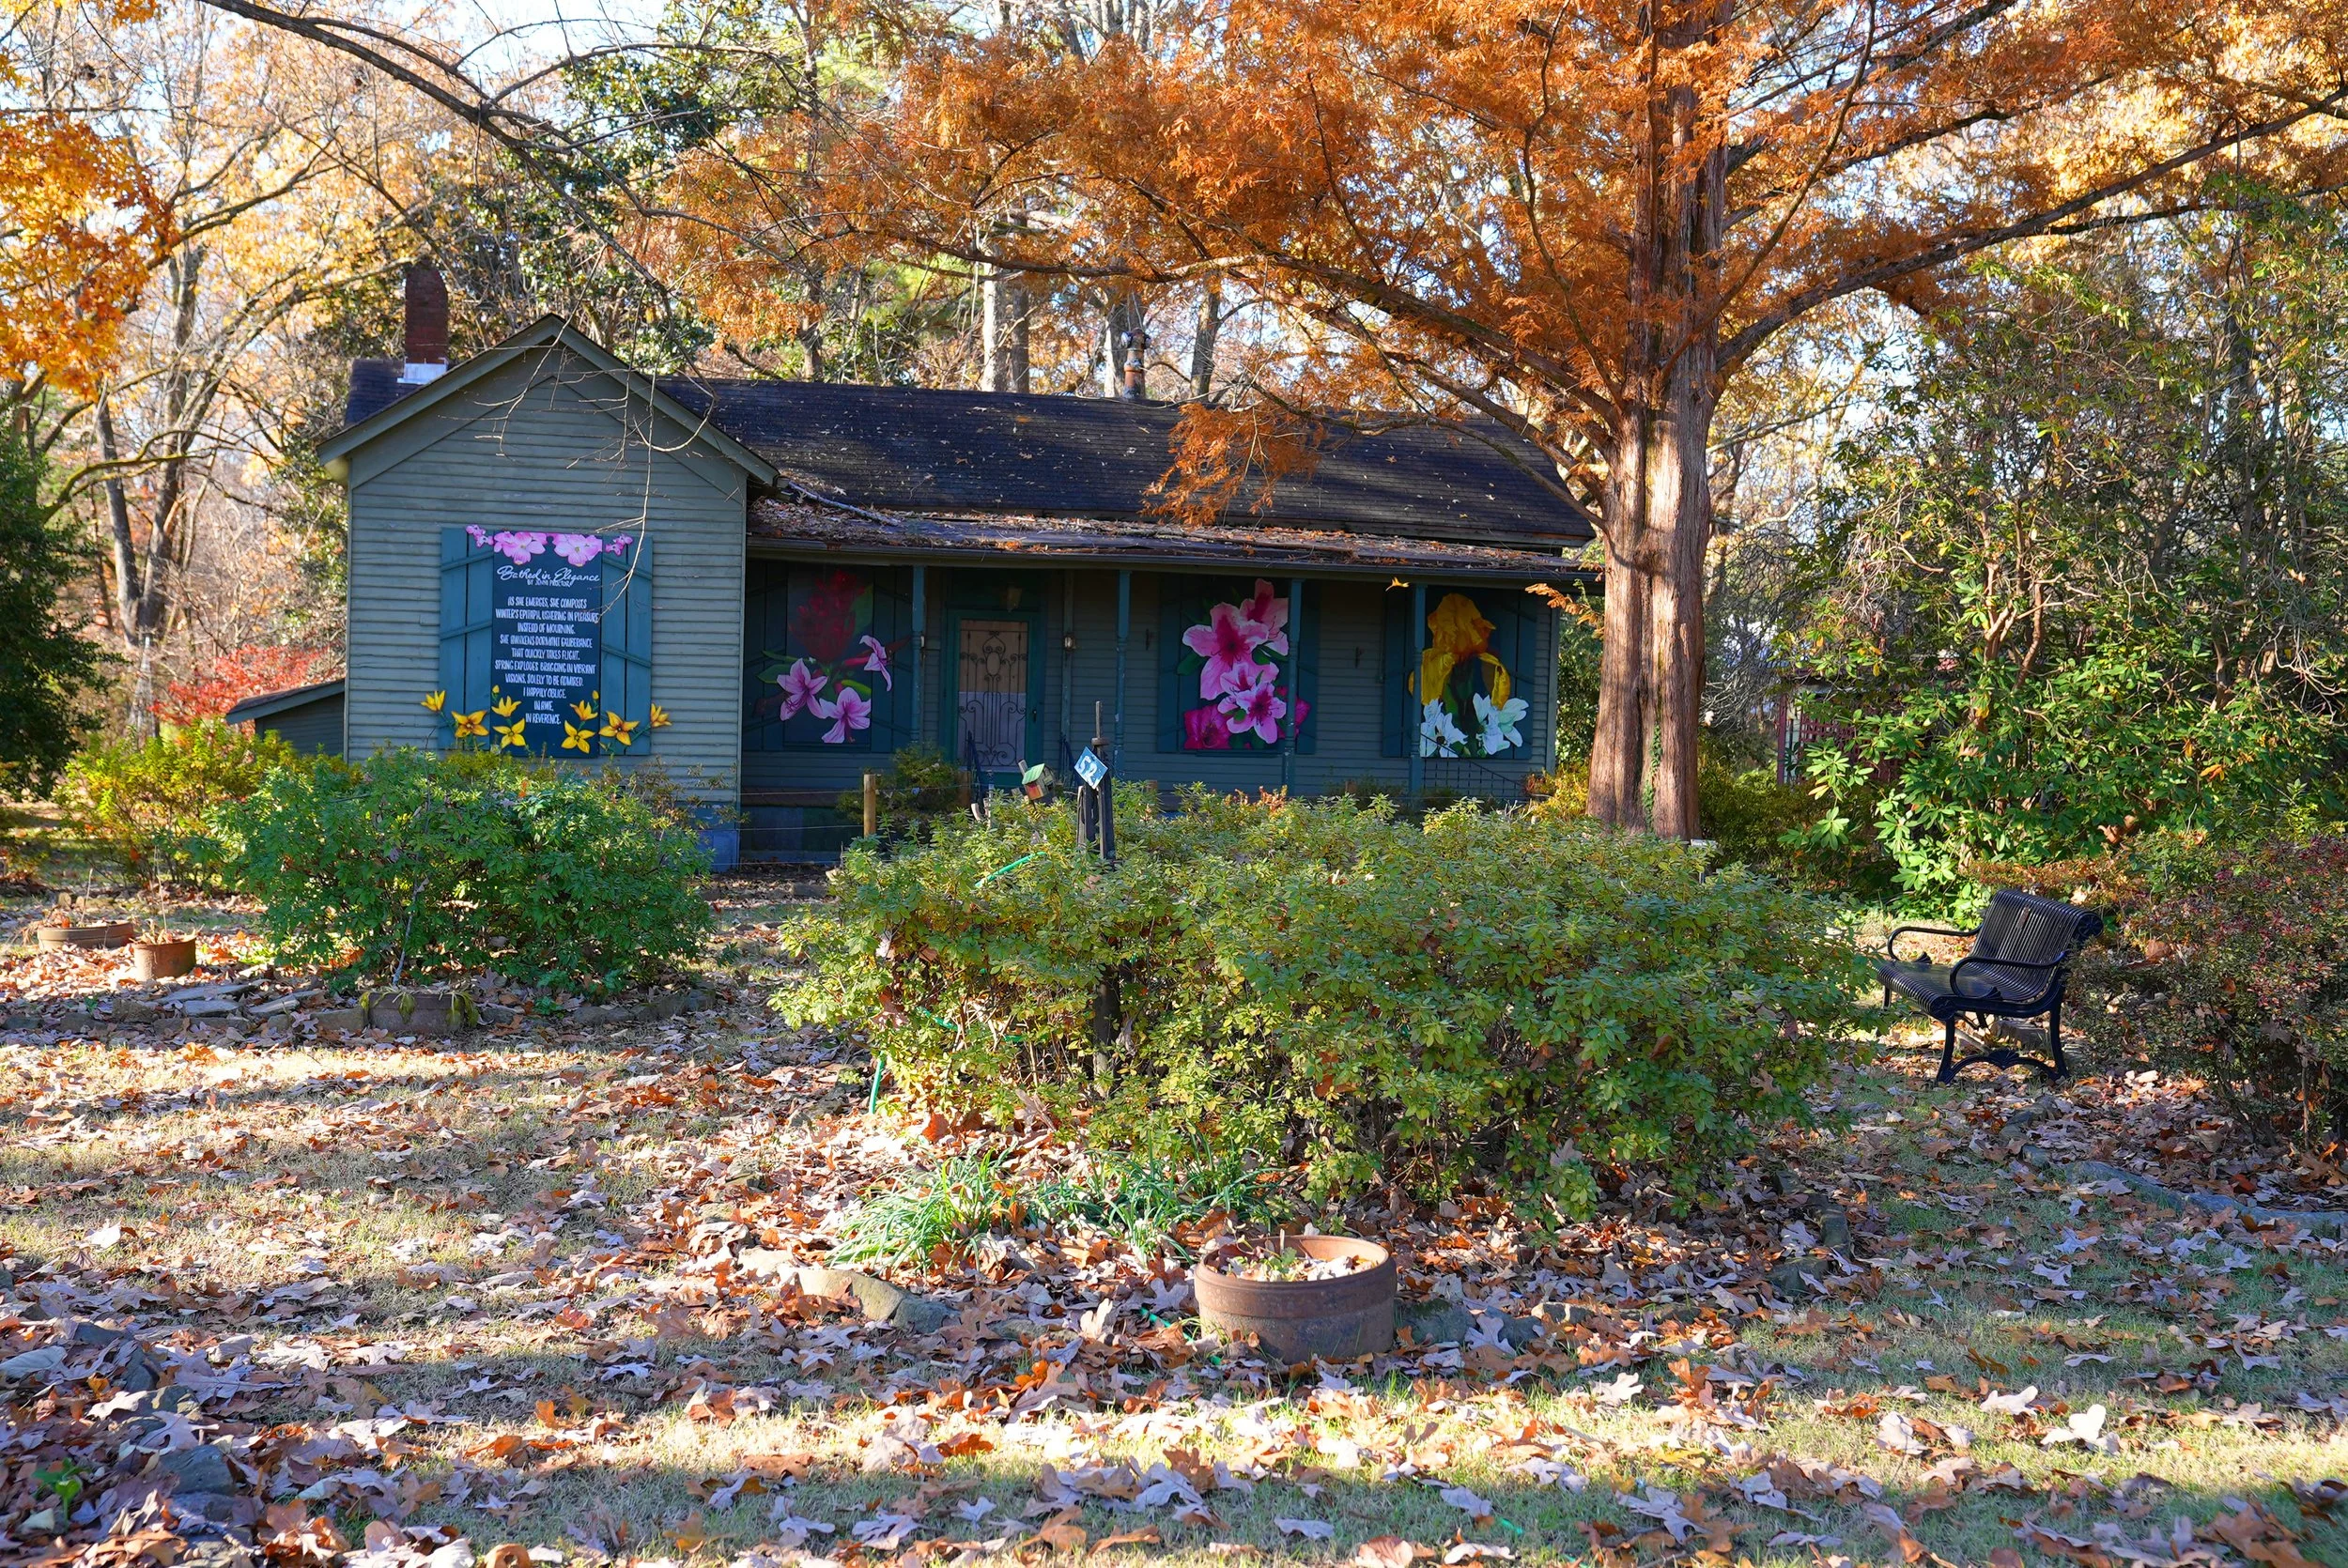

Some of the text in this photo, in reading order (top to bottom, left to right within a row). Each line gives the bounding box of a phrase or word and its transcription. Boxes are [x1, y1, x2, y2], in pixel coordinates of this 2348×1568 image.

[497, 565, 599, 586] Bathed in Elegance
[507, 596, 587, 608] AS SHE EMERGES, SHE COMPOSES
[495, 608, 518, 619] WINTER'S
[542, 610, 566, 621] USHERING
[567, 611, 573, 621] IN
[574, 612, 599, 623] PLEASURE
[517, 623, 576, 634] INSTEAD OF MOURNING.
[500, 634, 593, 648] SHE AWAKENS DORMANT EXUBERANCE
[511, 648, 580, 660] THAT QUICKLY TAKES FLIGHT.
[495, 660, 514, 669] SPRING
[540, 663, 566, 673] BRAGGING
[566, 664, 573, 673] IN
[573, 664, 596, 674] VIBRANT
[527, 674, 545, 684] SOLELY
[546, 674, 552, 684] TO
[552, 675, 559, 685] BE
[560, 676, 583, 686] ADMIRED.
[523, 687, 567, 699] I HAPPILY OBLIGE.
[533, 700, 540, 710] IN
[525, 714, 562, 725] IN REVERENCE.
